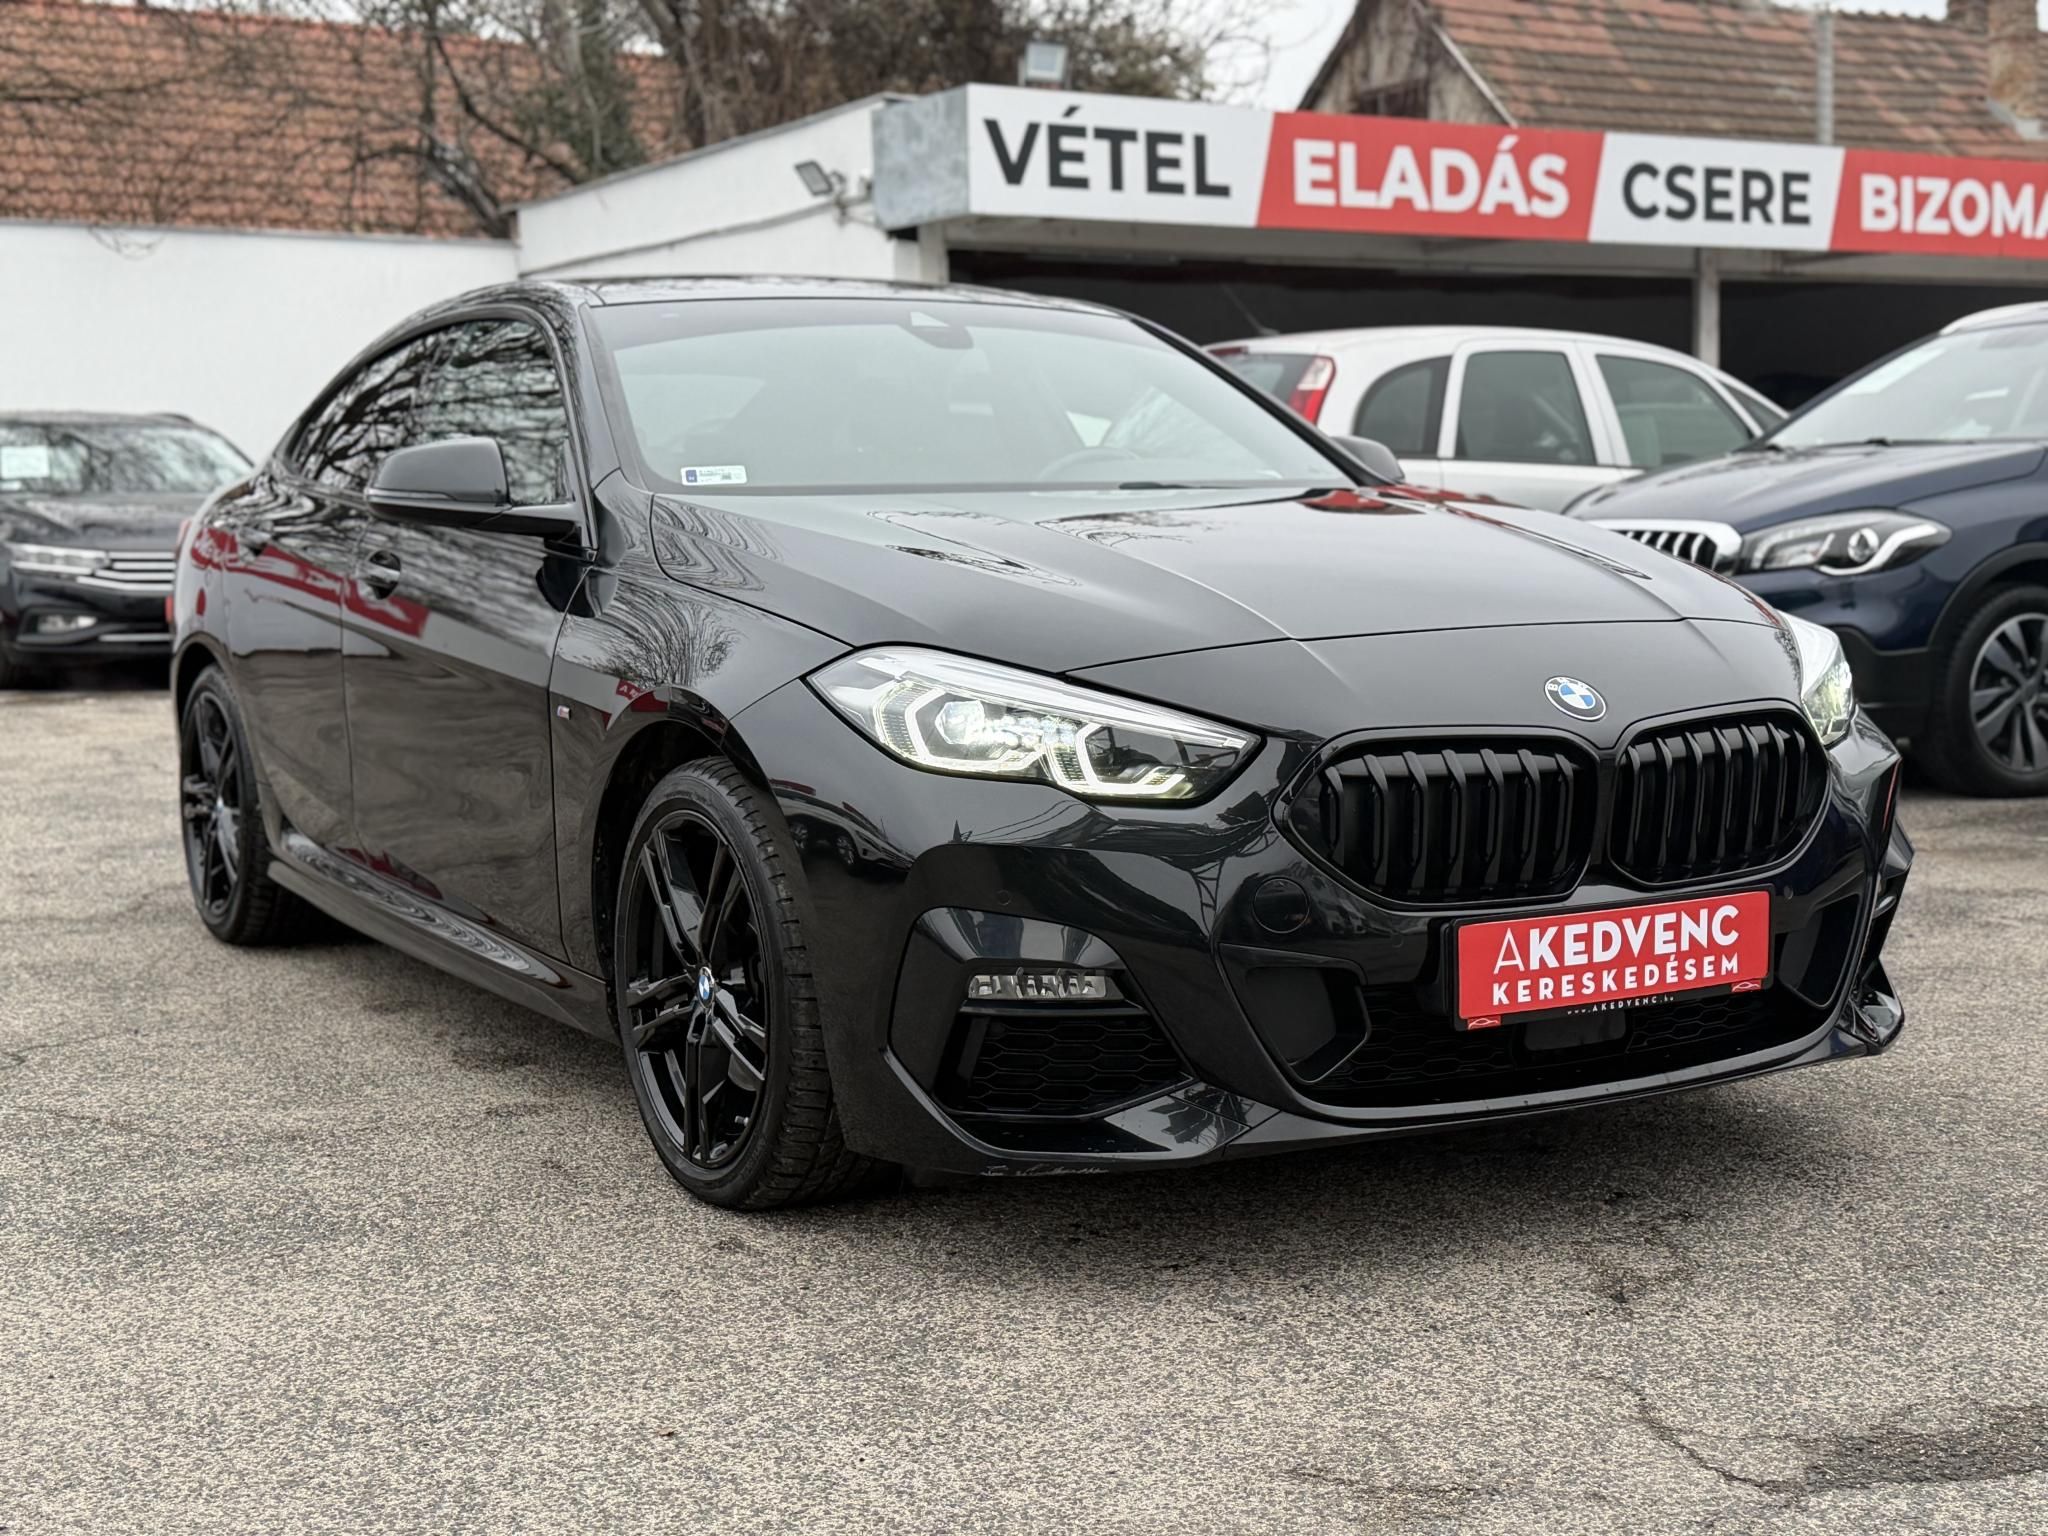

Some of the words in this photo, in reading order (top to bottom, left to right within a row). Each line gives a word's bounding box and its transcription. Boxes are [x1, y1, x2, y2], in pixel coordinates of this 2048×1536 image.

[982, 105, 1231, 198] VÉTEL
[1292, 135, 1569, 219] ELADÁS
[1621, 162, 1812, 226] CSERE
[1492, 952, 1739, 1006] KERESKEDÉSEM
